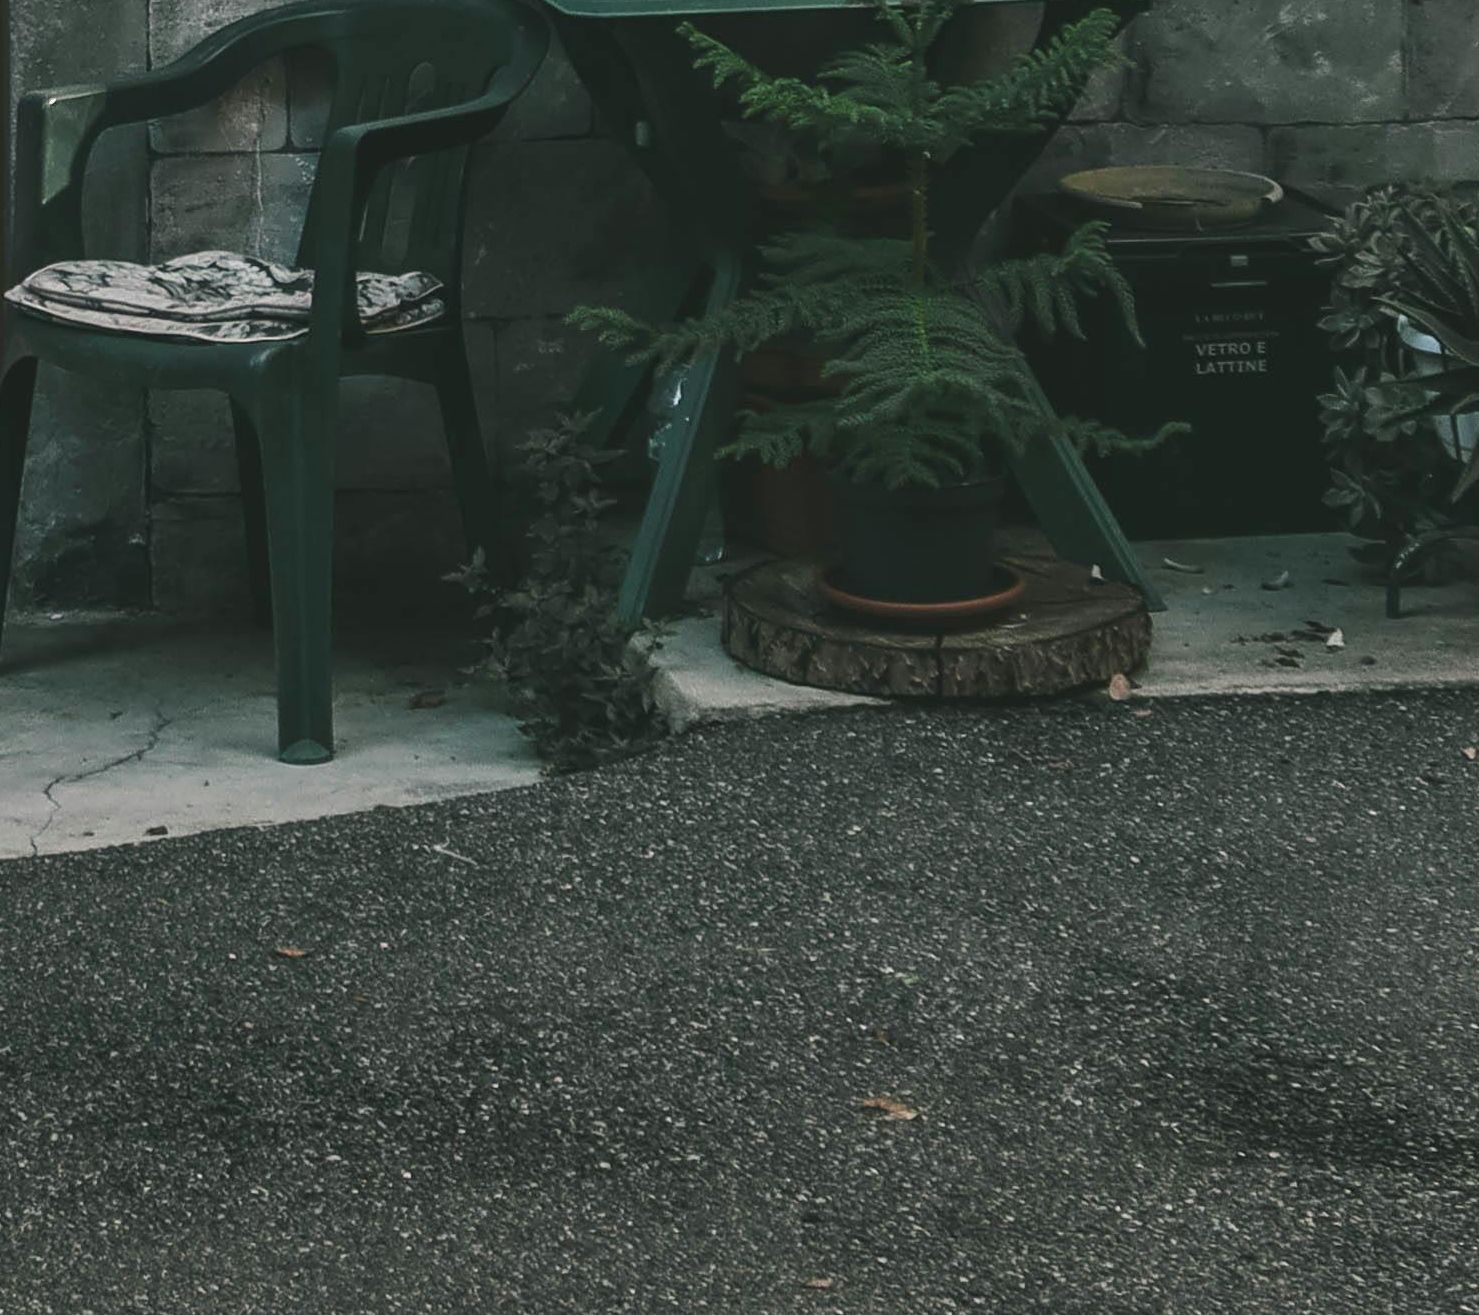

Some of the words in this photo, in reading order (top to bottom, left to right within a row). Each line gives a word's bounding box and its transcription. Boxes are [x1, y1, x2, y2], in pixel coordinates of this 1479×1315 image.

[1195, 342, 1251, 356] VETRO
[1257, 341, 1266, 354] E
[1196, 359, 1267, 374] LATTINE
